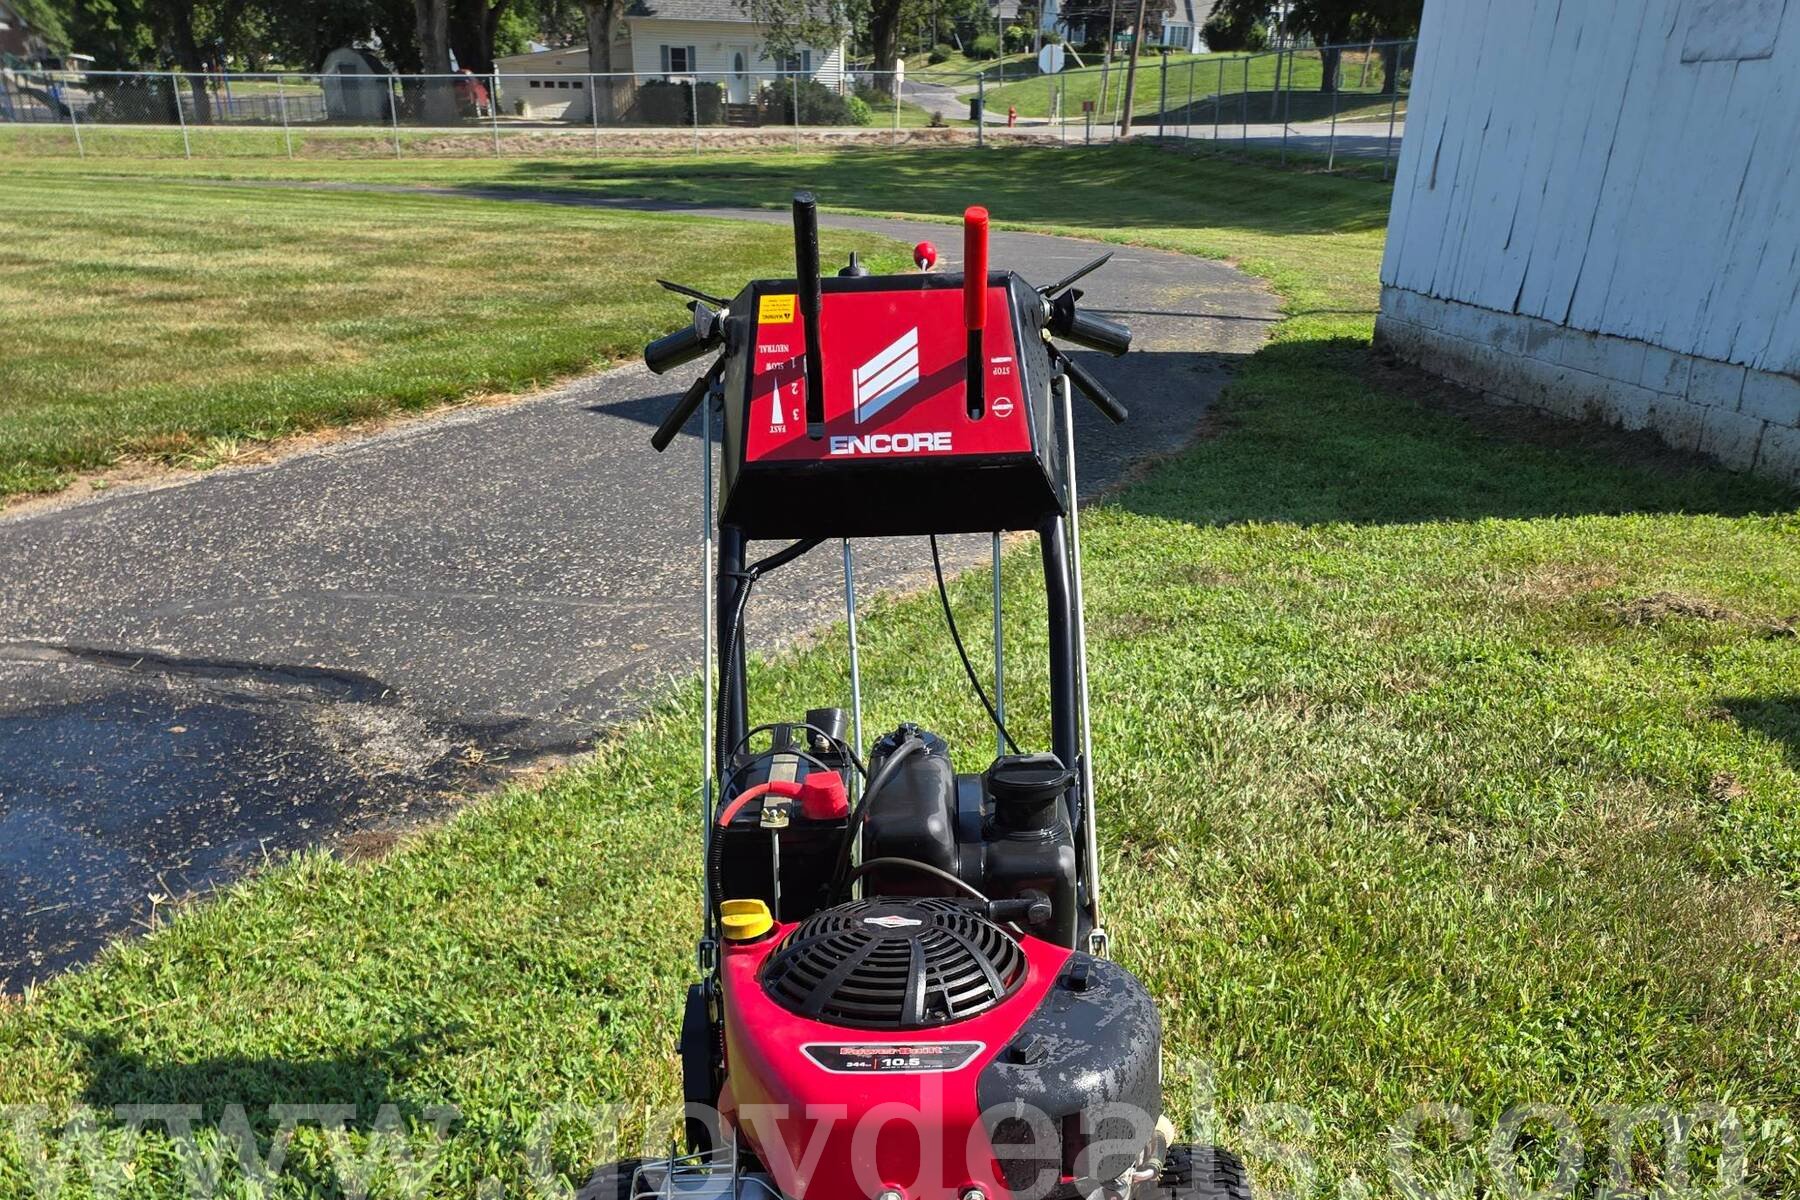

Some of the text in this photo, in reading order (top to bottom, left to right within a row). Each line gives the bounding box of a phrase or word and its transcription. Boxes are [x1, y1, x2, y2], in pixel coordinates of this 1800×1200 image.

[758, 344, 789, 353] NEUTRAL
[766, 361, 784, 371] SLOW
[992, 366, 1010, 375] STOP
[791, 383, 799, 395] 2
[792, 408, 799, 421] 3
[769, 424, 787, 433] FAST
[829, 431, 952, 455] ENCORE
[881, 1057, 920, 1066] 10.5
